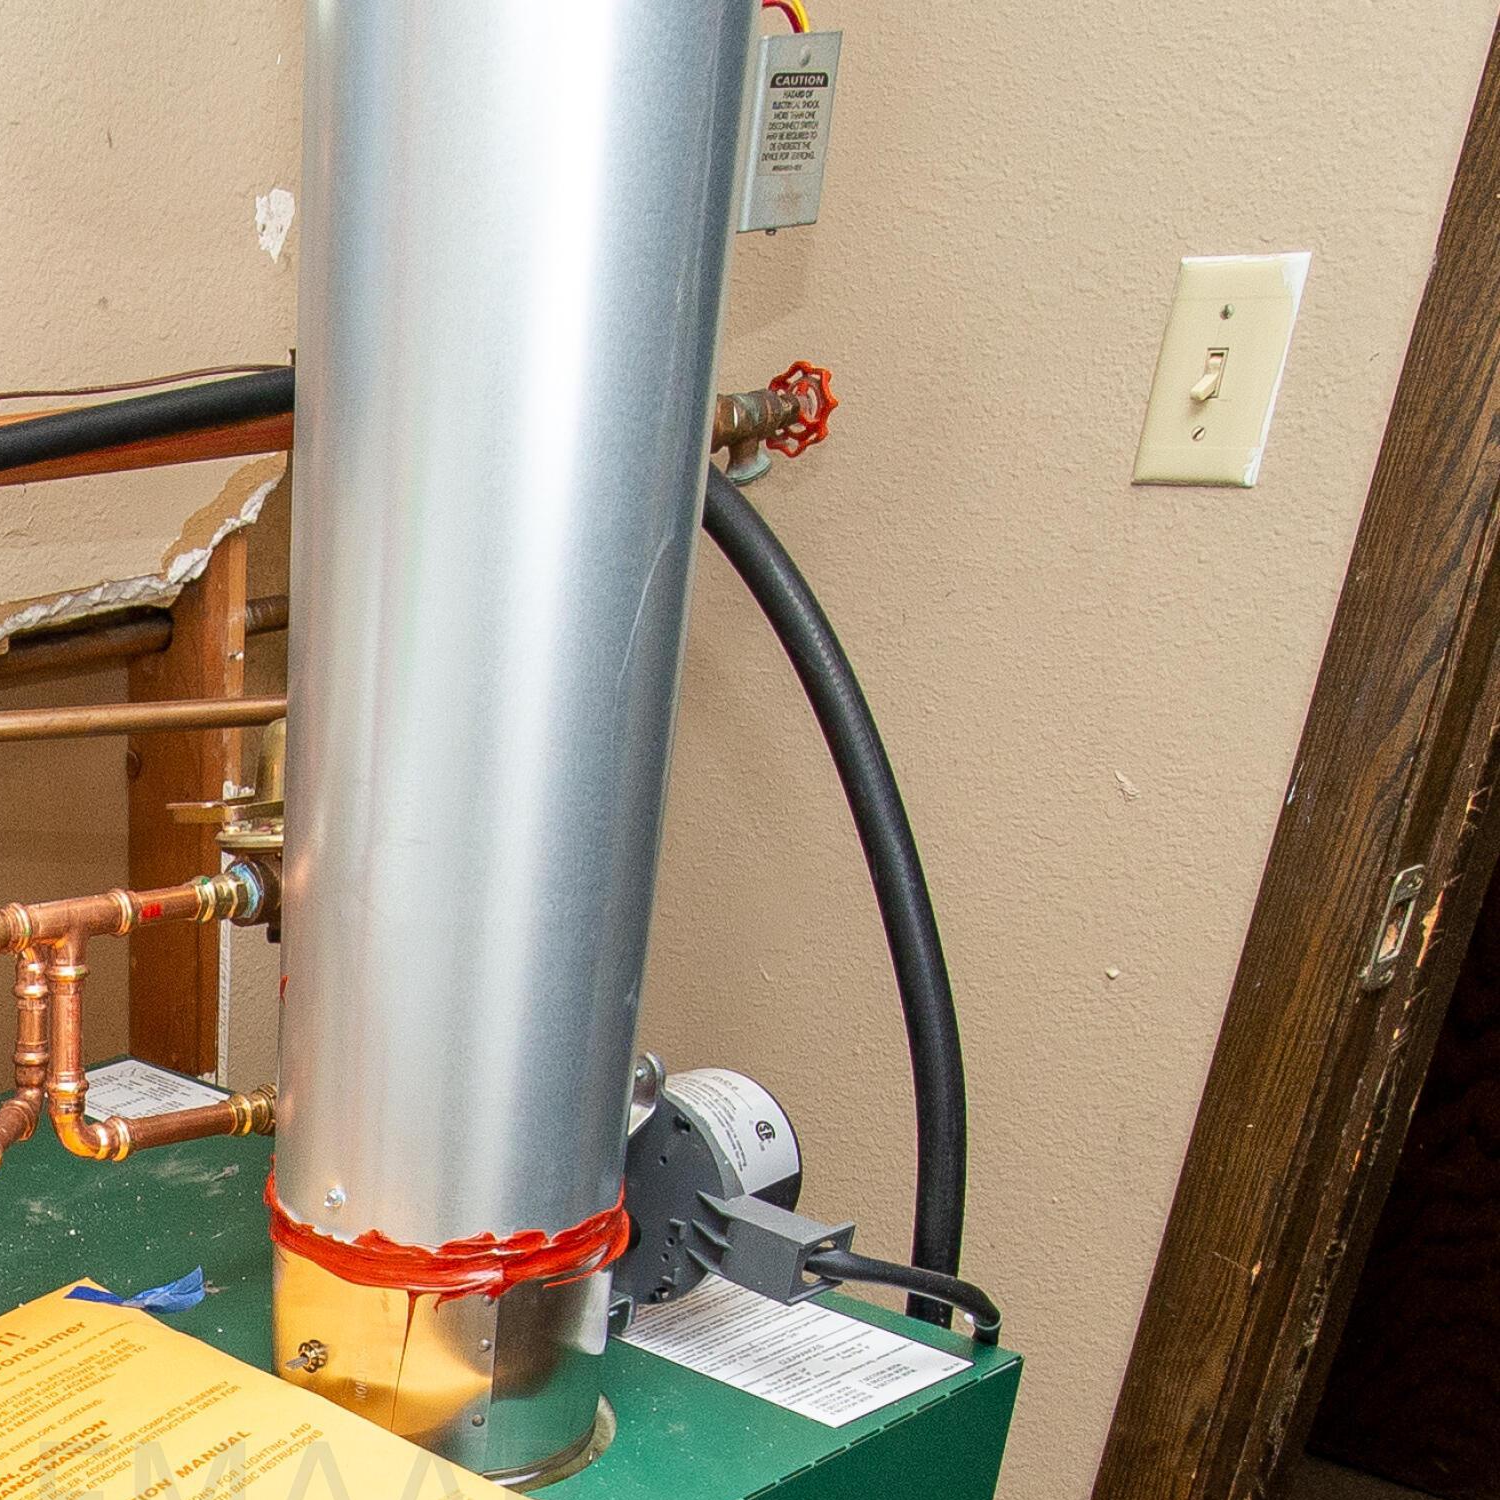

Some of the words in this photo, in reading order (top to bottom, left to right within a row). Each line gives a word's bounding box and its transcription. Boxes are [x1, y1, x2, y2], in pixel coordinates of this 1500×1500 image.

[775, 75, 824, 86] CAUTION
[107, 1337, 129, 1349] ARE
[12, 1395, 35, 1408] FOR
[7, 1424, 57, 1452] ENVELOPE
[16, 1419, 108, 1473] OPERATION
[42, 1430, 113, 1472] MANUAL
[52, 1442, 121, 1482] INSTRUCTIONS
[117, 1431, 140, 1445] FOR
[136, 1404, 186, 1434] COMPLETE
[183, 1379, 230, 1407] ASSEMBLY
[82, 1443, 139, 1477] ADDITIONAL
[136, 1409, 198, 1445] INSTRUCTION
[194, 1395, 221, 1410] DATA
[218, 1384, 242, 1397] FOR
[174, 1428, 253, 1478] MANUAL
[213, 1469, 242, 1486] FOR
[238, 1438, 289, 1469] LIGHTING
[286, 1422, 314, 1438] AND
[227, 1471, 262, 1493] BASIC
[255, 1429, 325, 1473] INSTRUCTIONS
